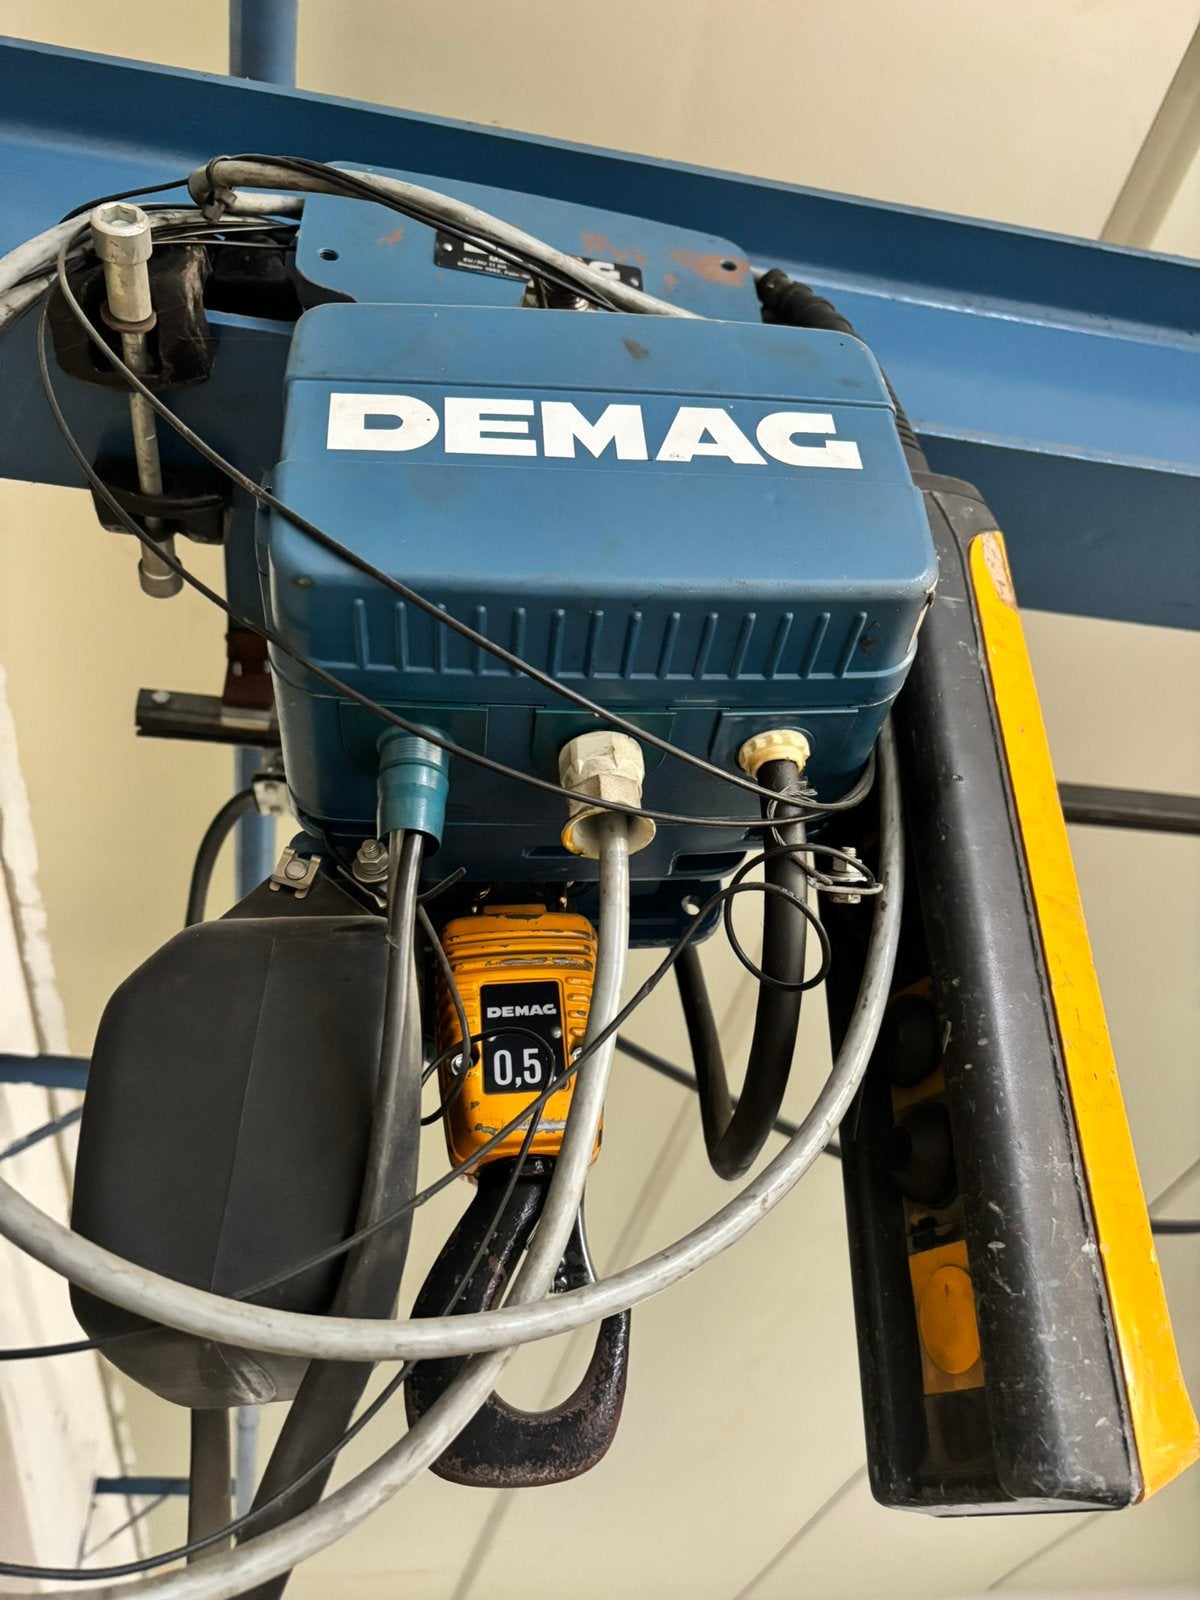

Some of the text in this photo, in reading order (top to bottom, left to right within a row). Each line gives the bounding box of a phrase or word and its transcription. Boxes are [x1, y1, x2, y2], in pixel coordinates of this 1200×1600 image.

[327, 393, 863, 470] DEMAG
[486, 1003, 557, 1019] DEMAG
[493, 1048, 542, 1088] 0,5
